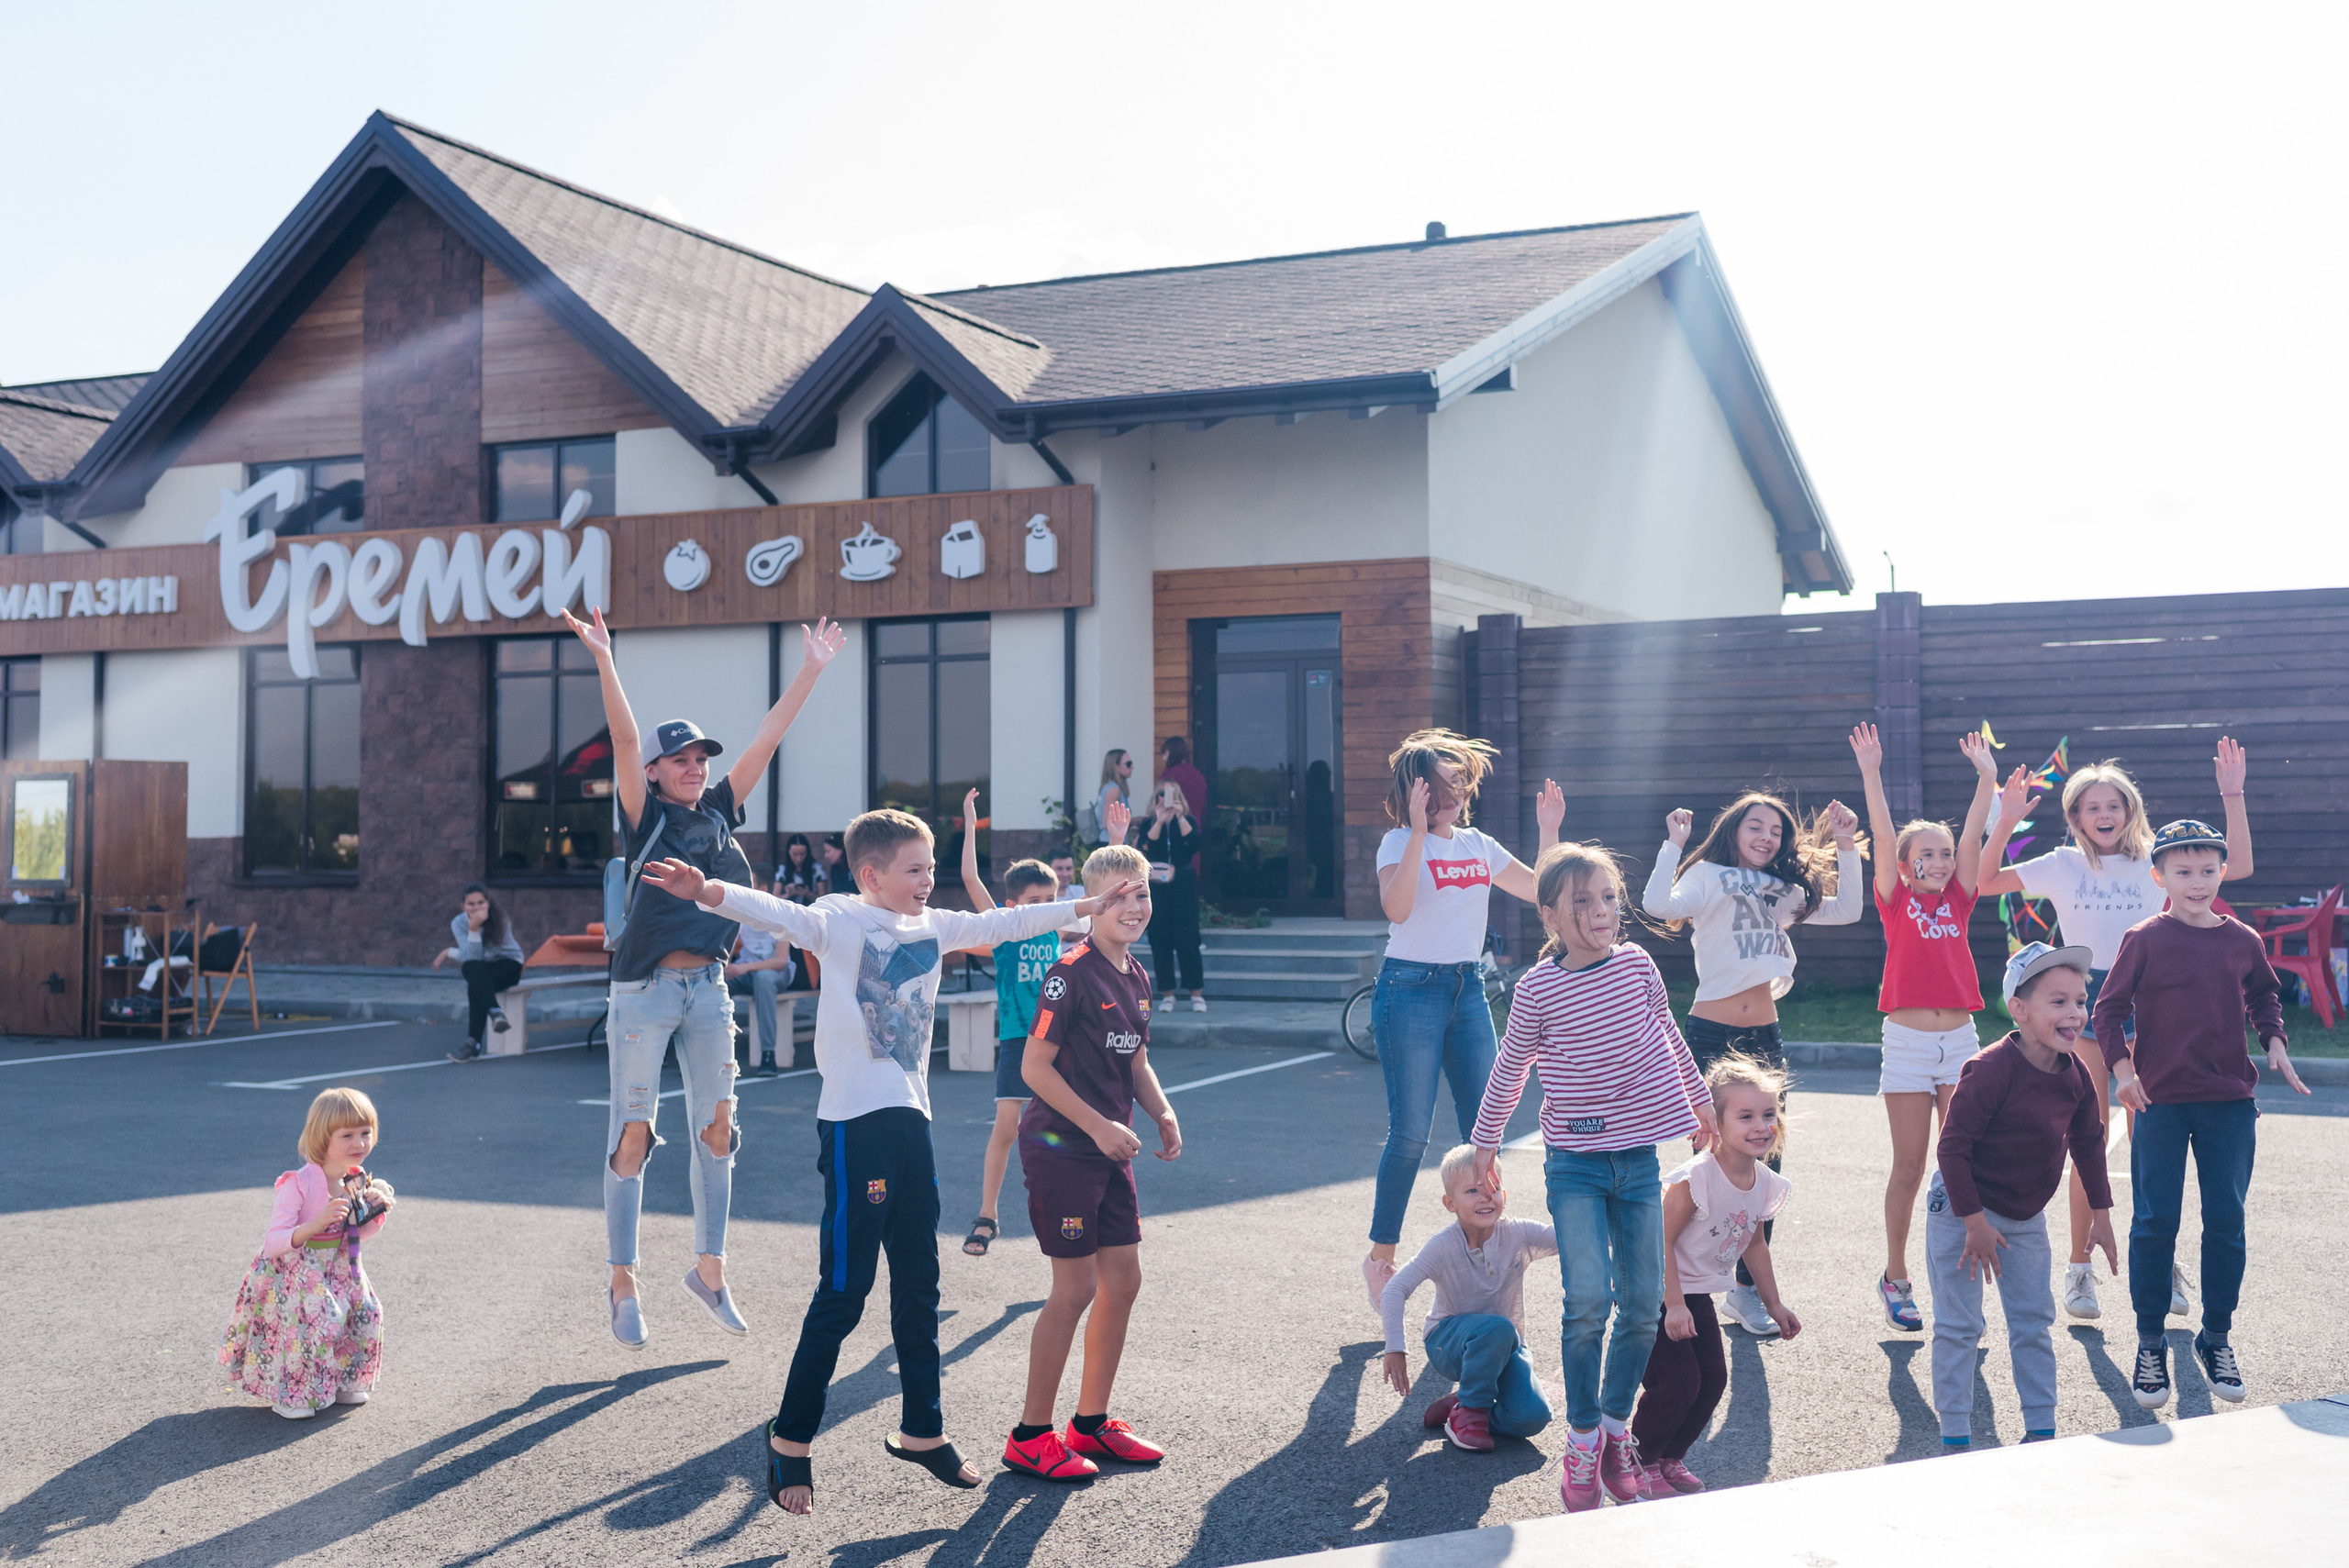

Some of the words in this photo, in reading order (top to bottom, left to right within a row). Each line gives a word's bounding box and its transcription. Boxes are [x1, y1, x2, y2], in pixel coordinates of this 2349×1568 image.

[0, 575, 178, 620] МАГАЗИН
[2074, 903, 2143, 911] FRIENDS
[1916, 917, 1961, 940] Love
[1019, 943, 1052, 962] COCO
